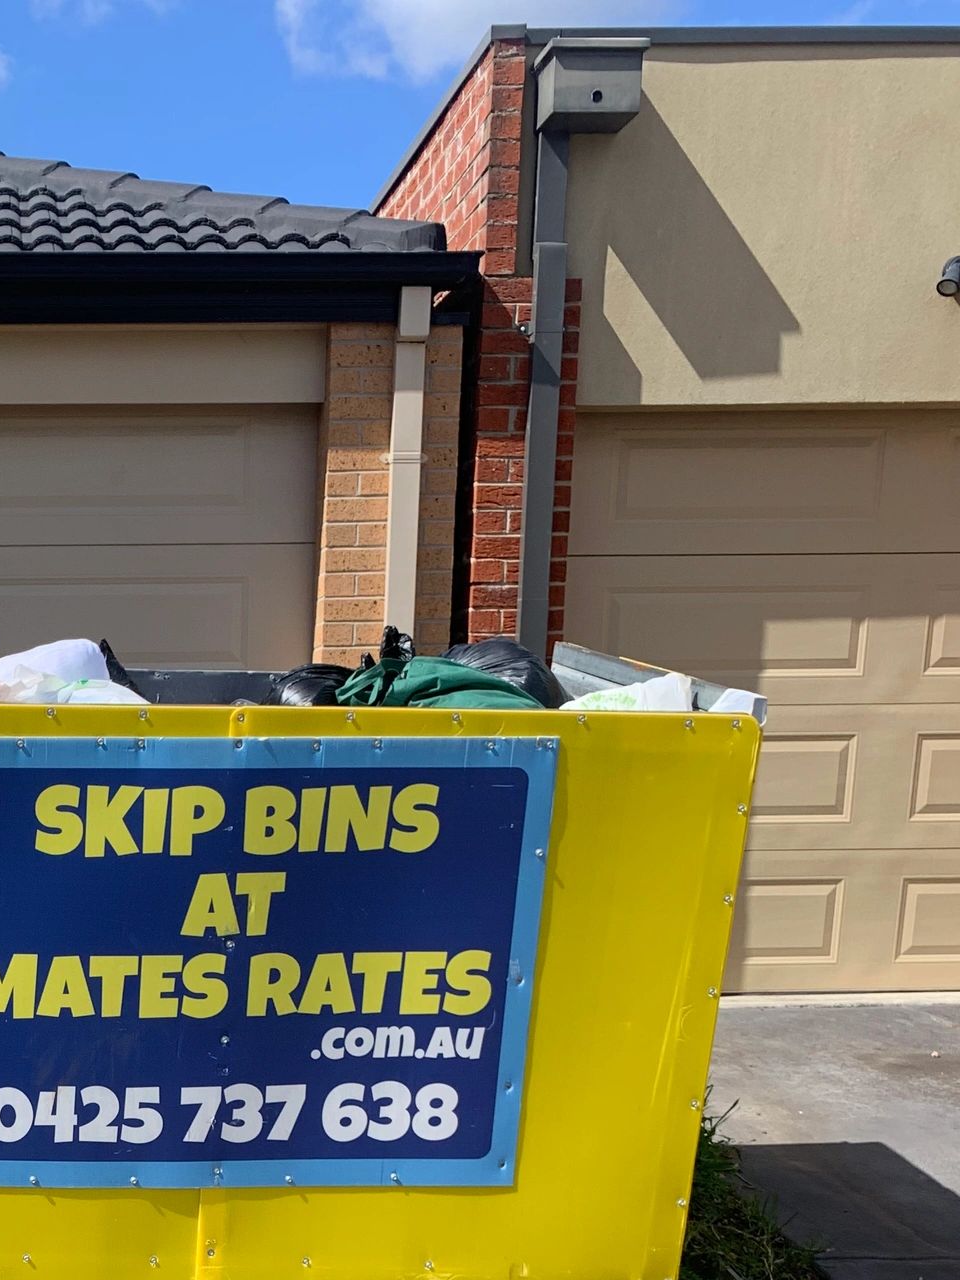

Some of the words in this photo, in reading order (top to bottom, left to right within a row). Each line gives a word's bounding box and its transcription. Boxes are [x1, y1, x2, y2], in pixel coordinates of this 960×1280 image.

[34, 784, 226, 857] SKIP
[243, 783, 440, 855] BINS
[180, 872, 286, 937] AT
[246, 949, 492, 1017] RATES
[180, 1083, 307, 1143] 737
[321, 1080, 459, 1142] 638
